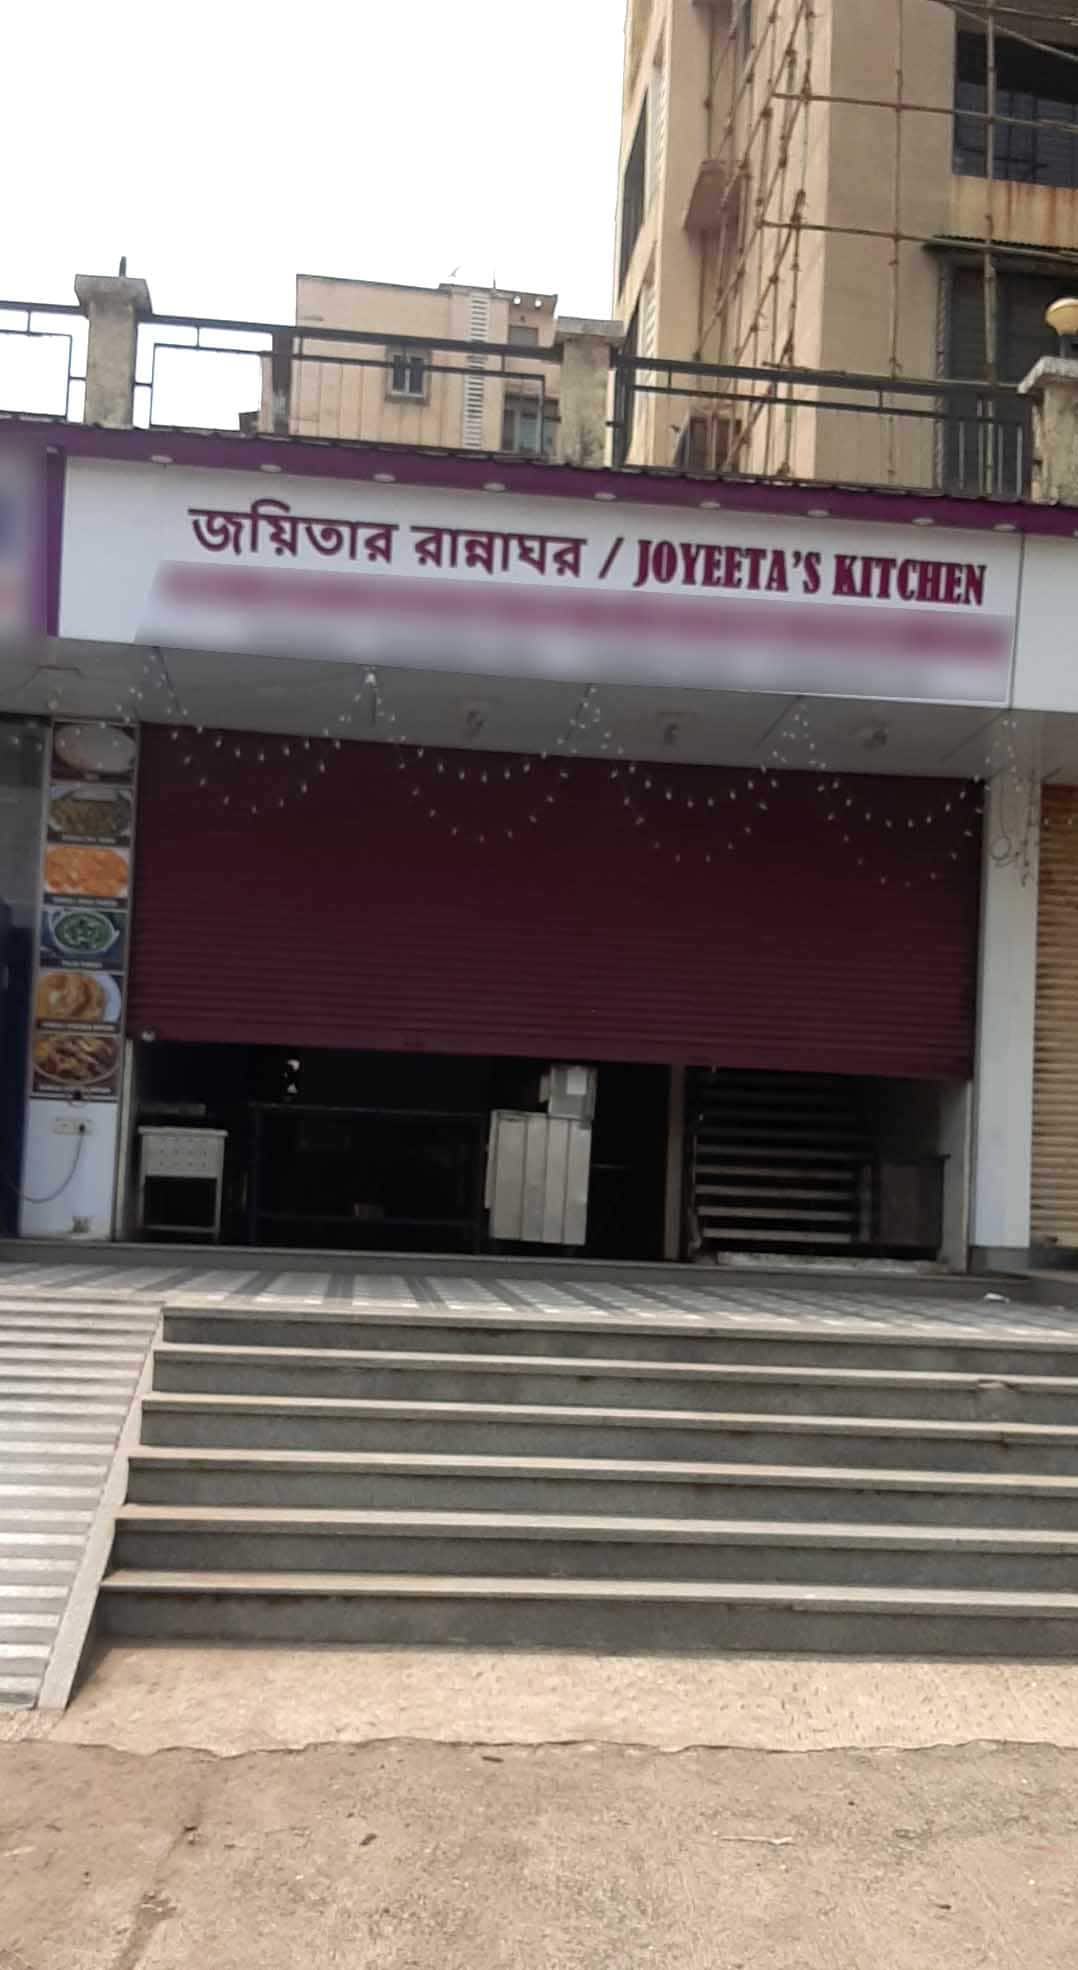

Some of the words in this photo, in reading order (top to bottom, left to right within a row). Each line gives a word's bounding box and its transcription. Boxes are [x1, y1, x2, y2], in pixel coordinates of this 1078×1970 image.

[188, 498, 399, 563] জয়িতার
[410, 525, 588, 578] রান্নাঘর
[598, 536, 625, 580] /
[633, 539, 822, 594] JOYEETA'S
[832, 554, 988, 606] KITCHEN
